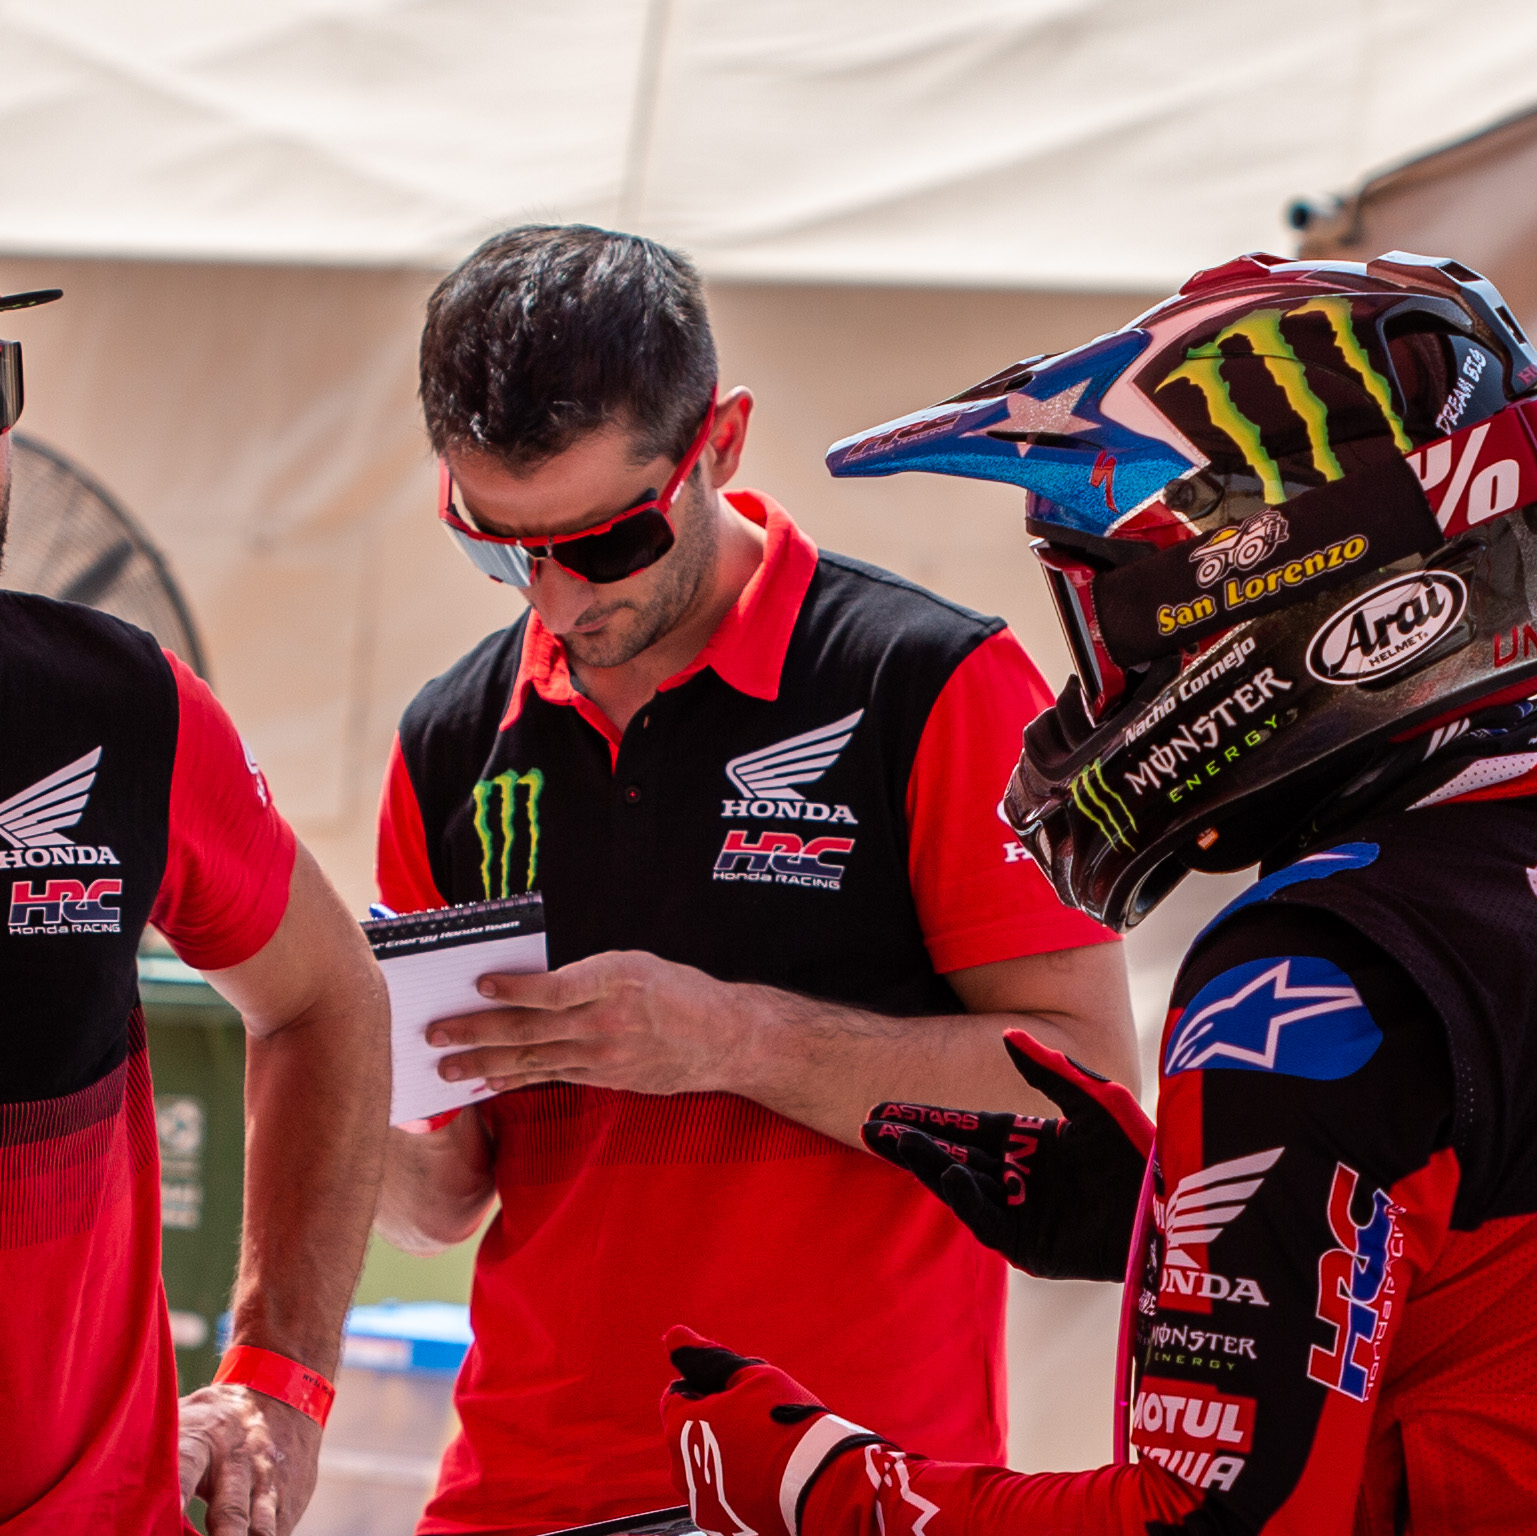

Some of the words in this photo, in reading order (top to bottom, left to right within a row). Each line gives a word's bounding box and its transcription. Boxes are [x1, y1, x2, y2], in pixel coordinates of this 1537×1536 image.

[1435, 377, 1475, 435] DREAM
[1463, 348, 1487, 382] BIG
[1158, 595, 1215, 636] San
[1224, 534, 1368, 610] Lorenzo
[1329, 574, 1448, 677] Arai
[1368, 632, 1419, 668] HELMET
[1123, 696, 1176, 747] Nacho
[1179, 636, 1257, 702] Cornejo
[1124, 667, 1293, 796] MONSTER
[1169, 714, 1278, 803] ENERGY
[721, 799, 859, 824] HONDA
[713, 830, 856, 880] HRC
[713, 871, 773, 882] Honda
[775, 874, 841, 891] RACING
[8, 878, 123, 926] HRC
[9, 925, 69, 935] Honda
[71, 923, 121, 933] RACING
[880, 1104, 979, 1131] ASTARS
[1307, 1160, 1395, 1403] HRC
